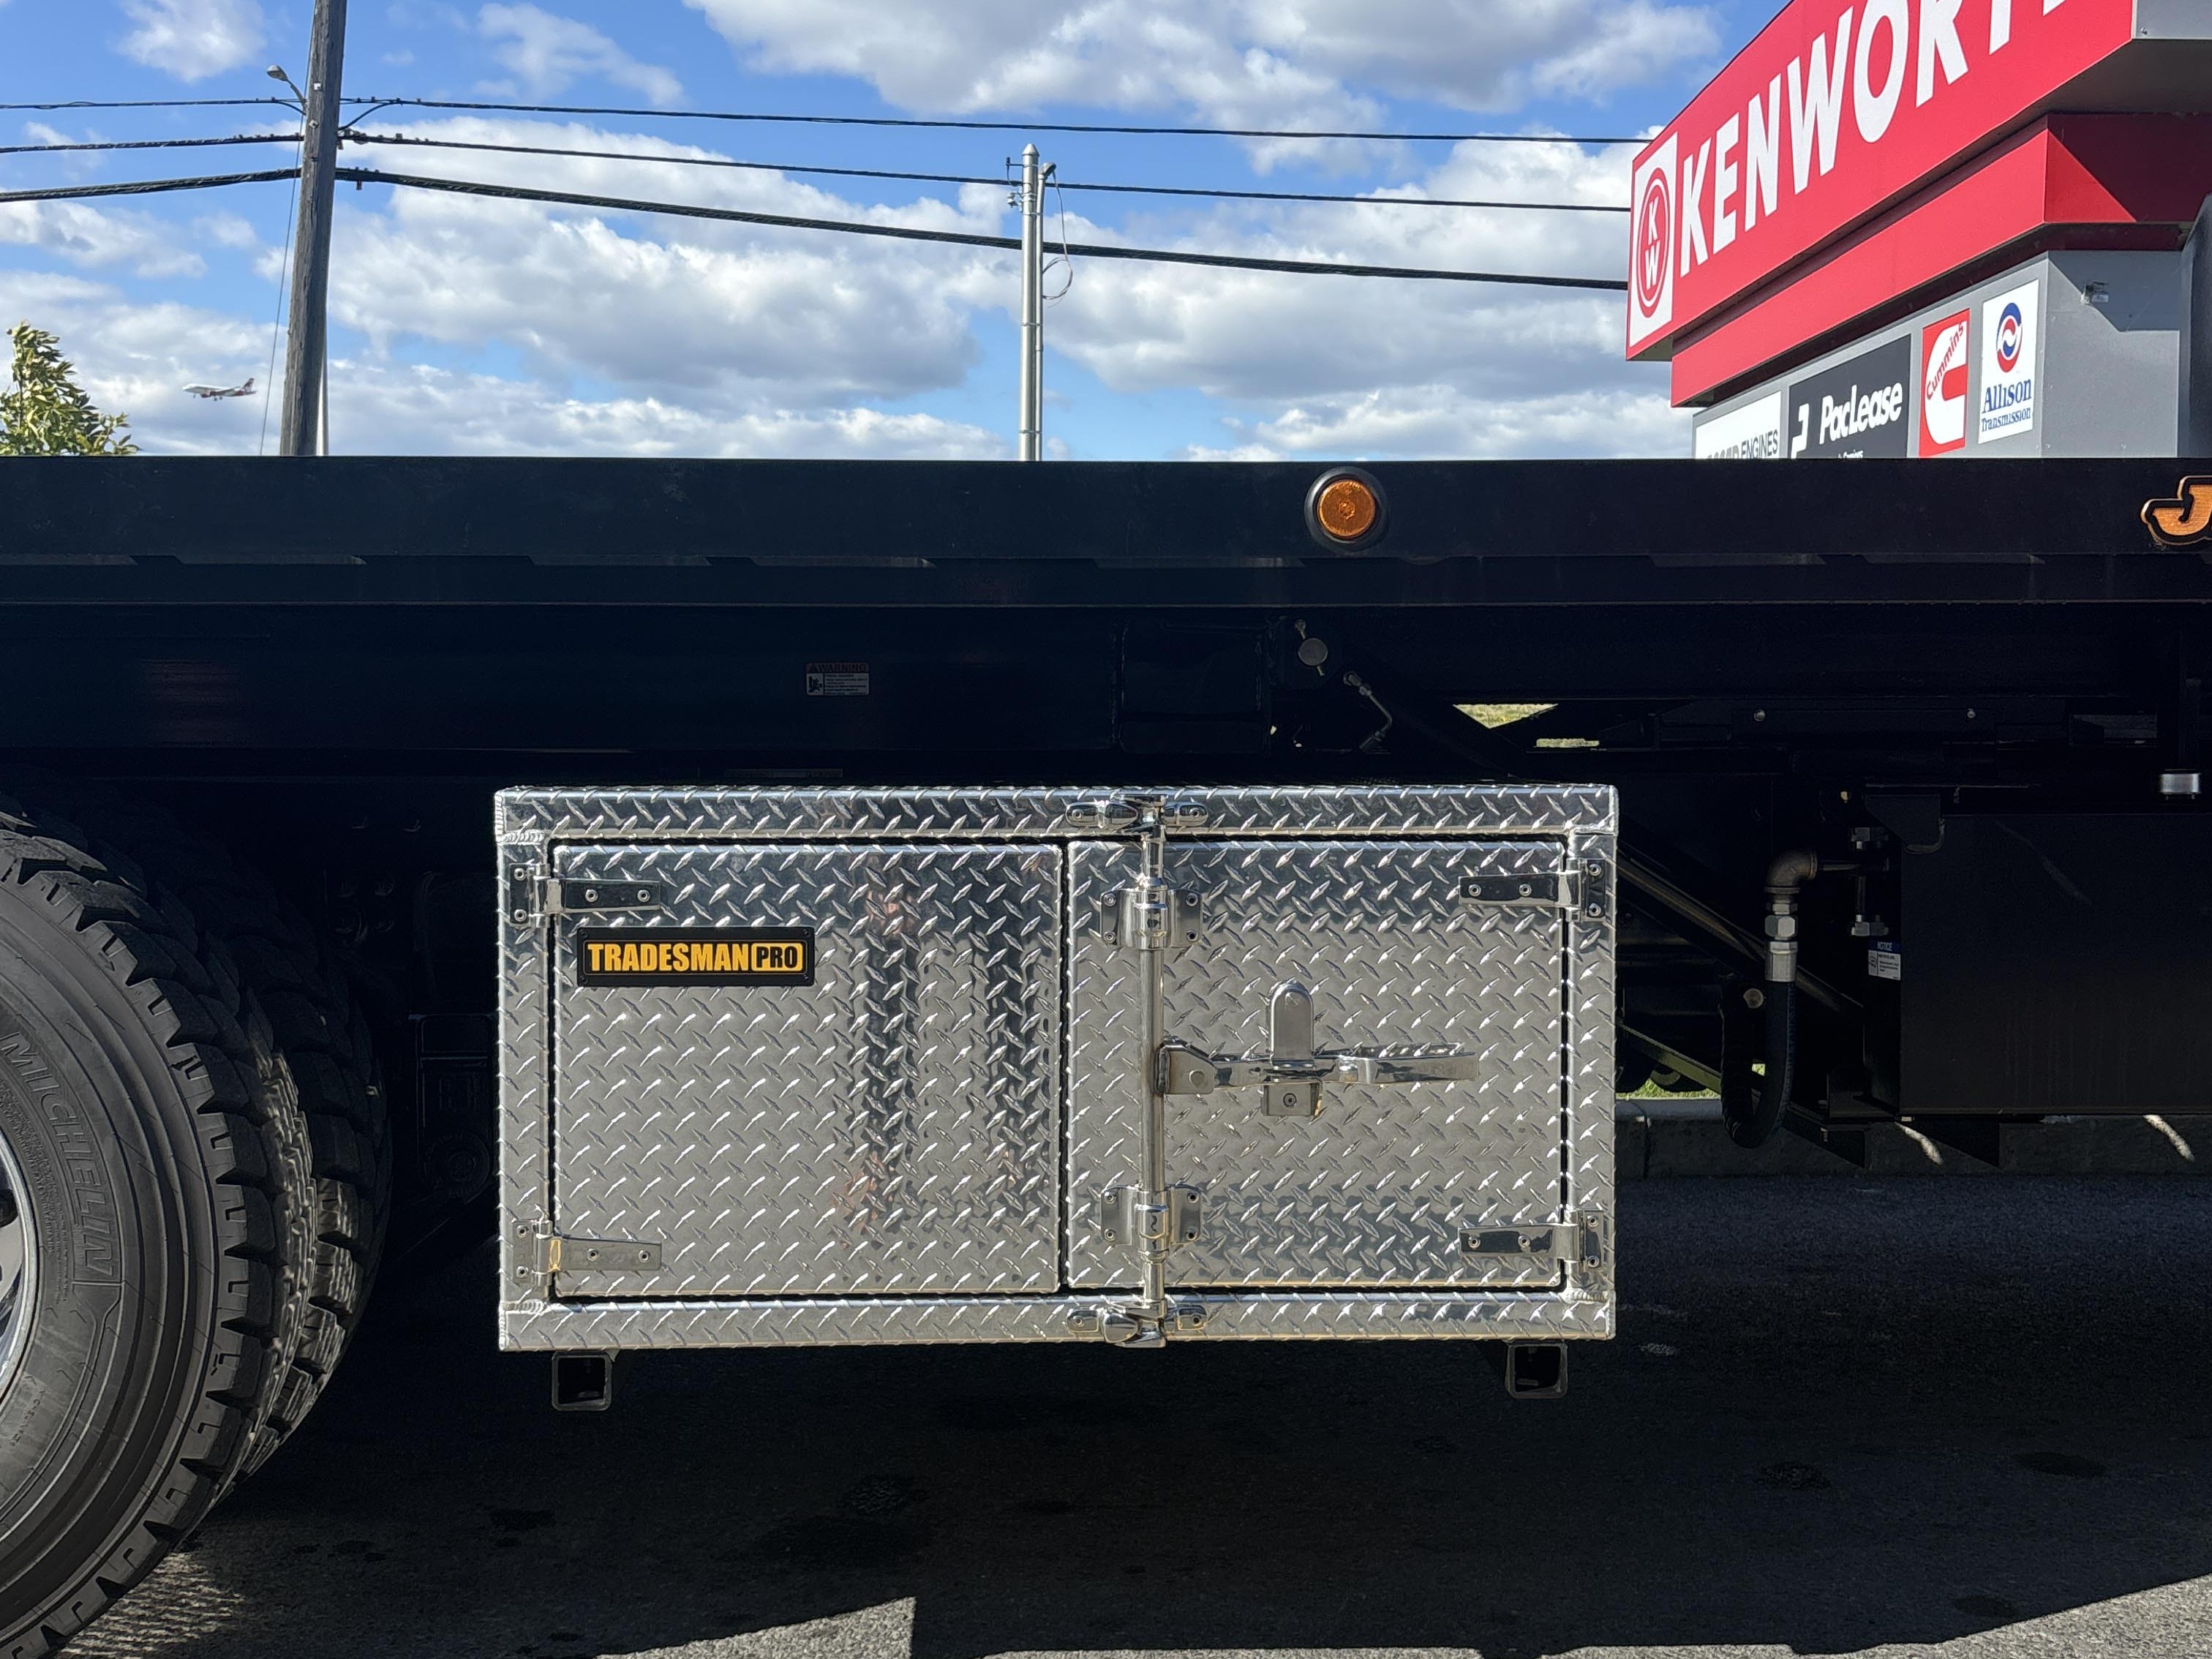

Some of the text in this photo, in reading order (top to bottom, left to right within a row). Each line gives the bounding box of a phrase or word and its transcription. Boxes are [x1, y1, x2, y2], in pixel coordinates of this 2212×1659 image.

[1680, 0, 2066, 277] KENWOR
[1926, 323, 1965, 400] Cummins
[1819, 383, 1903, 445] PacLease
[1982, 378, 2032, 414] Allison
[1981, 407, 2031, 432] Transmission
[1741, 429, 1778, 459] ENGINES
[819, 663, 867, 673] WARNING
[587, 943, 799, 972] TRADESMAN PRO
[1, 1031, 113, 1276] MICHELIN
